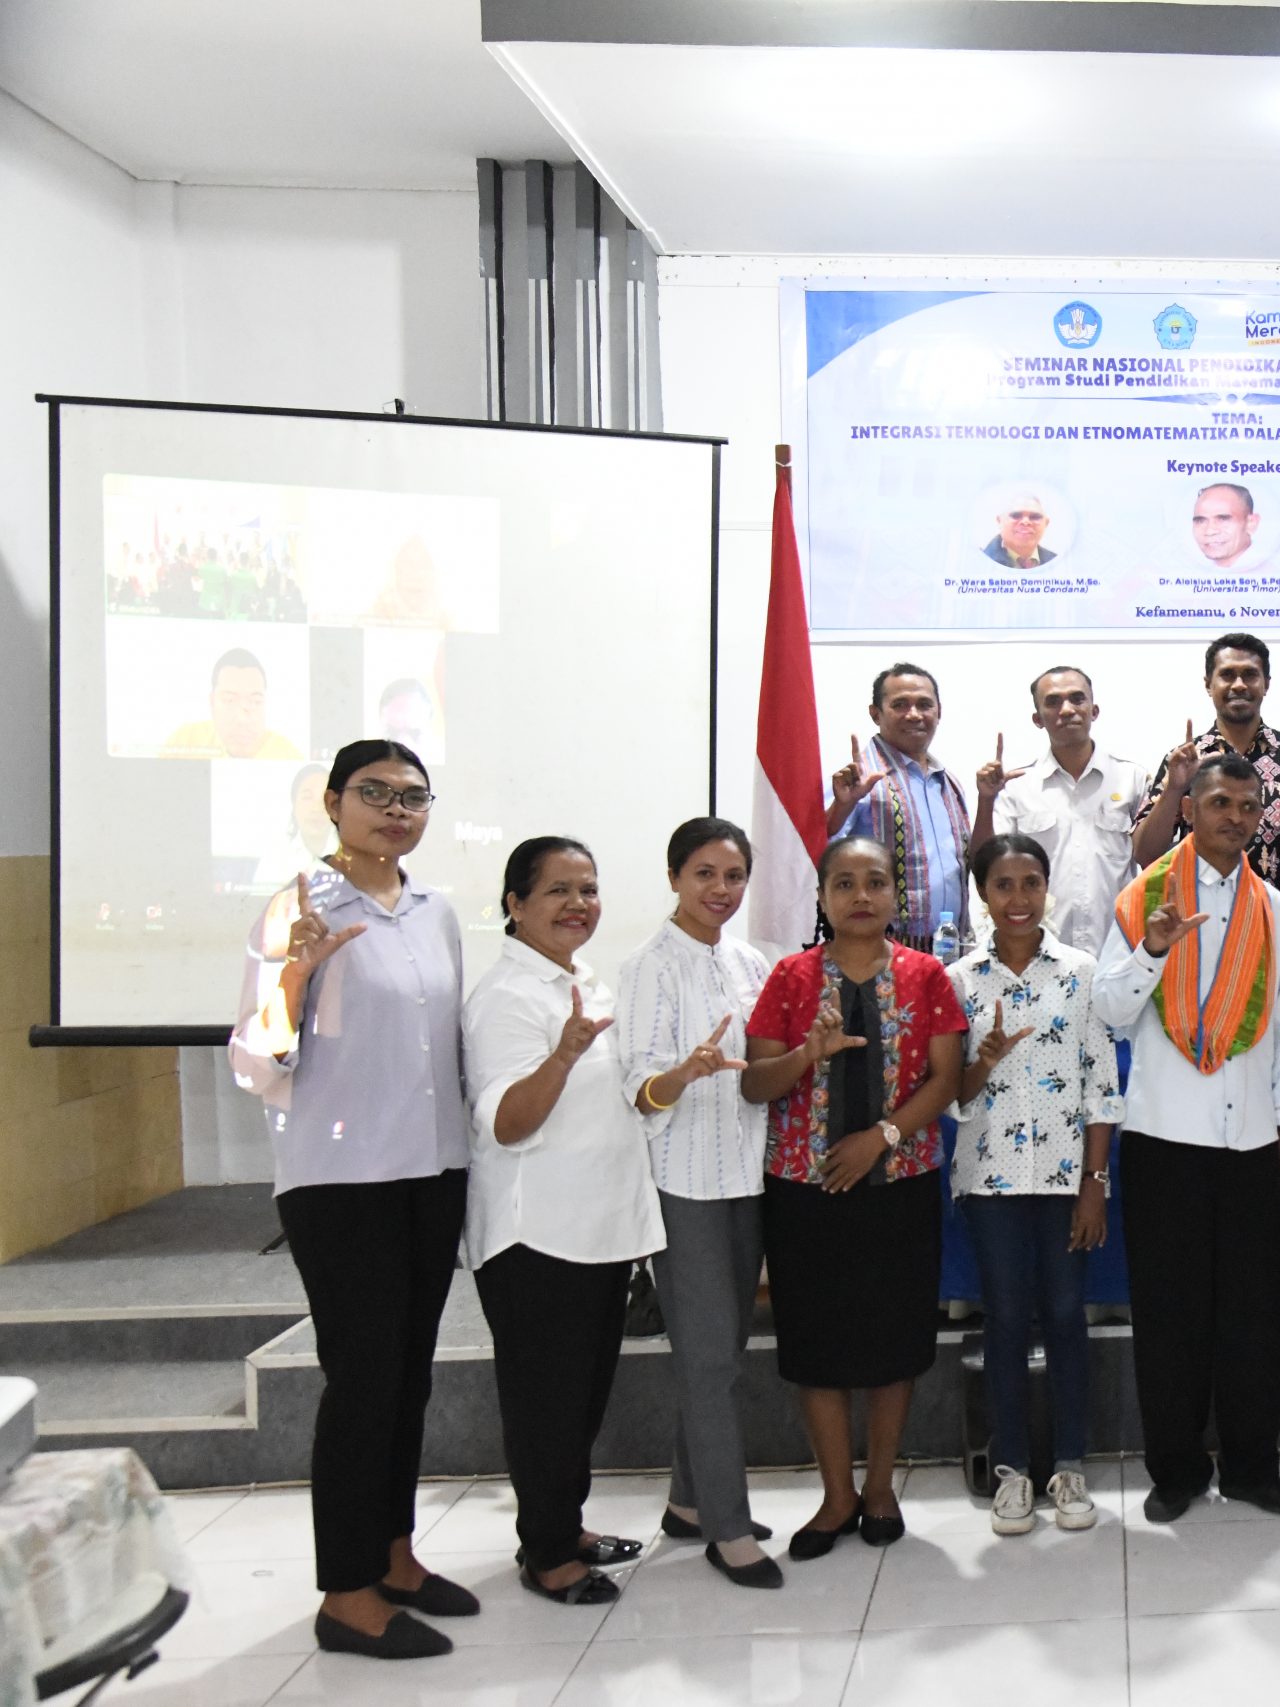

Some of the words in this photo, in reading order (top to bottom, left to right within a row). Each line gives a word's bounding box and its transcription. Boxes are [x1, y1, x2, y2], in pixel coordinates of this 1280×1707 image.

[1003, 357, 1088, 372] SEMINAR
[1092, 357, 1185, 373] NASIONAL
[1065, 373, 1110, 386] Studi
[1114, 373, 1210, 387] Pendidikan
[1212, 412, 1263, 425] TEMA:
[850, 425, 942, 439] INTEGRASI
[945, 425, 1041, 440] TEKNOLOGI
[1044, 426, 1080, 440] DAN
[1083, 426, 1241, 441] ETNOMATEMATIKA
[1167, 459, 1228, 476] Keynote
[944, 578, 959, 586] Dr.
[961, 578, 986, 586] Wara
[988, 578, 1018, 586] Sabon
[1159, 578, 1173, 586] Dr.
[1175, 578, 1212, 586] Aloisius
[1238, 578, 1259, 586] Son,
[957, 585, 1015, 594] (Universitas
[1017, 585, 1041, 593] Nusa
[1043, 585, 1089, 594] Cendana)
[1193, 585, 1249, 594] (Universitas
[1135, 605, 1226, 618] Kefamenanu,
[1229, 606, 1237, 617] 6
